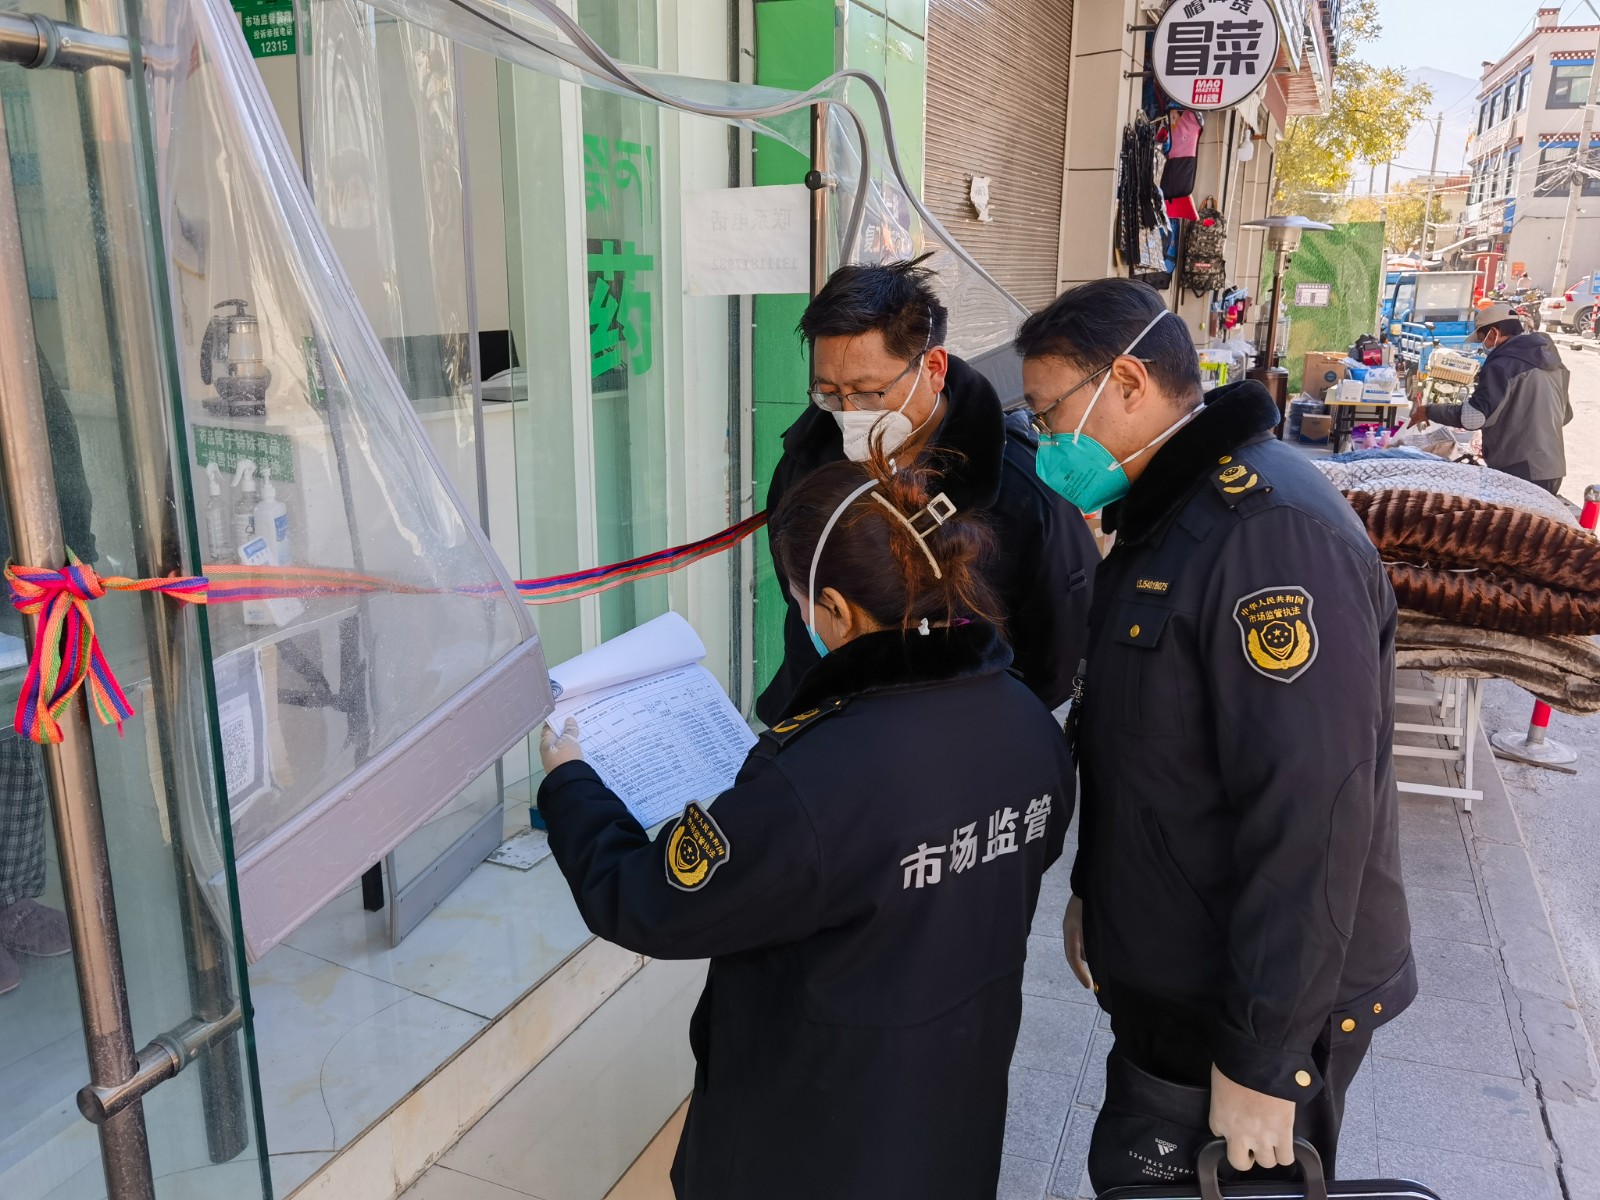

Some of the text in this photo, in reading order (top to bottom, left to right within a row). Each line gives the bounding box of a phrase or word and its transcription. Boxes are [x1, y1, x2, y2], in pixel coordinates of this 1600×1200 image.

[1183, 0, 1253, 19] 帽货
[260, 40, 288, 53] 12315
[1165, 20, 1264, 76] 冒菜
[1195, 79, 1221, 89] MAO
[1240, 595, 1305, 617] 中华人民共和国
[1248, 606, 1302, 624] 市场监管执法
[686, 815, 717, 859] 市场监管执法
[688, 806, 726, 856] 中华人民共和国
[899, 793, 1052, 890] 市场监管
[1154, 1137, 1178, 1150] adidas
[1128, 1150, 1163, 1168] STRIPES
